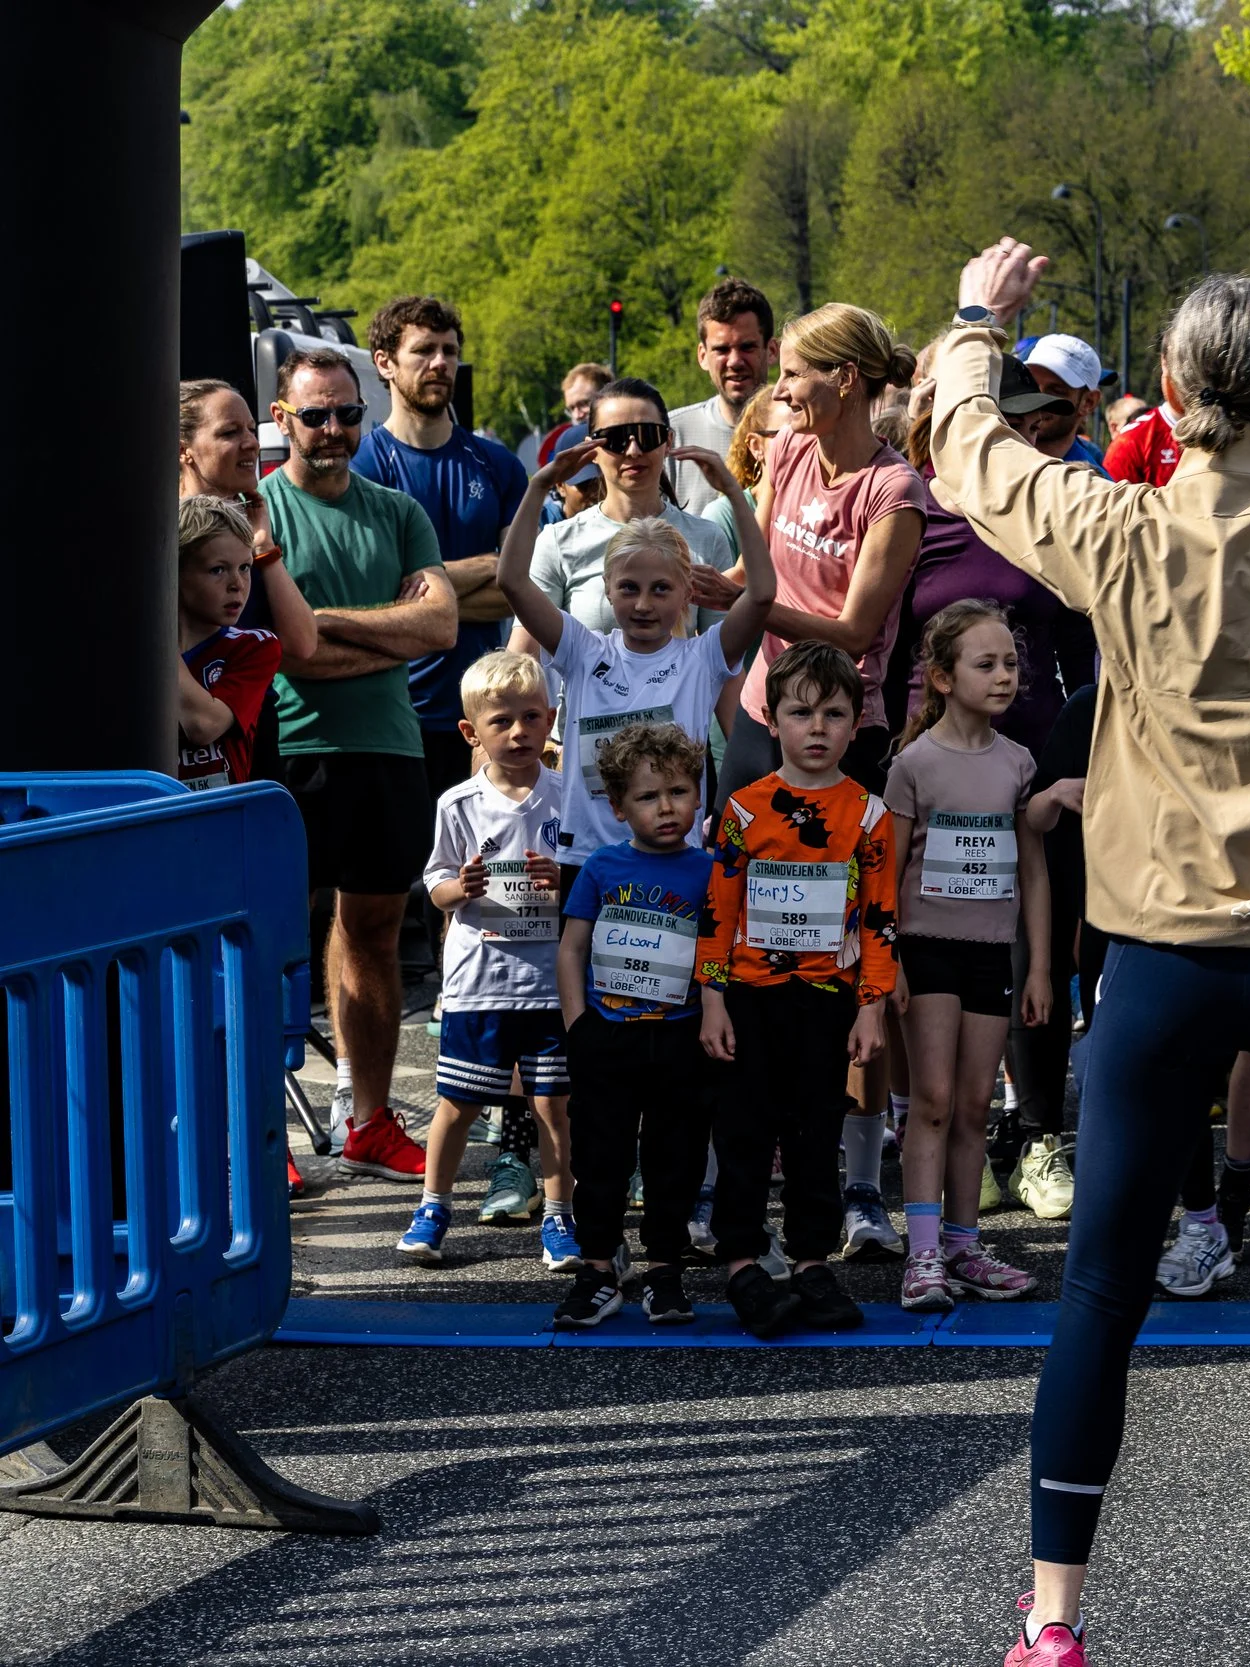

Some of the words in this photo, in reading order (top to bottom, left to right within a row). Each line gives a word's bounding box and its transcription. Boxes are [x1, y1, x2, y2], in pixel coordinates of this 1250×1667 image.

[774, 514, 848, 557] SAYSKY
[615, 683, 629, 693] Nor
[936, 813, 993, 828] STRANDVEJEN
[955, 836, 996, 848] FREYA
[965, 849, 987, 858] REES
[755, 862, 814, 877] STRANDVEJEN
[816, 865, 828, 877] 5K
[962, 863, 987, 875] 452
[948, 877, 998, 887] GENTOFTE
[749, 878, 788, 906] Henry
[793, 884, 804, 902] S
[948, 886, 998, 895] LØBEKLUB
[504, 893, 550, 902] SANDFELD
[516, 906, 540, 917] 171
[605, 907, 663, 926] STRANDVEJEN
[665, 918, 678, 929] 5K
[782, 912, 807, 925] 589
[504, 921, 552, 929] GENTOFTE
[504, 929, 552, 938] LØBEKLUB
[770, 927, 821, 938] GENTOFTE
[770, 937, 821, 947] LØBEKLUB
[623, 958, 650, 972] 588
[610, 972, 661, 987] GENTOFTE
[610, 981, 660, 996] LØBEKLUB
